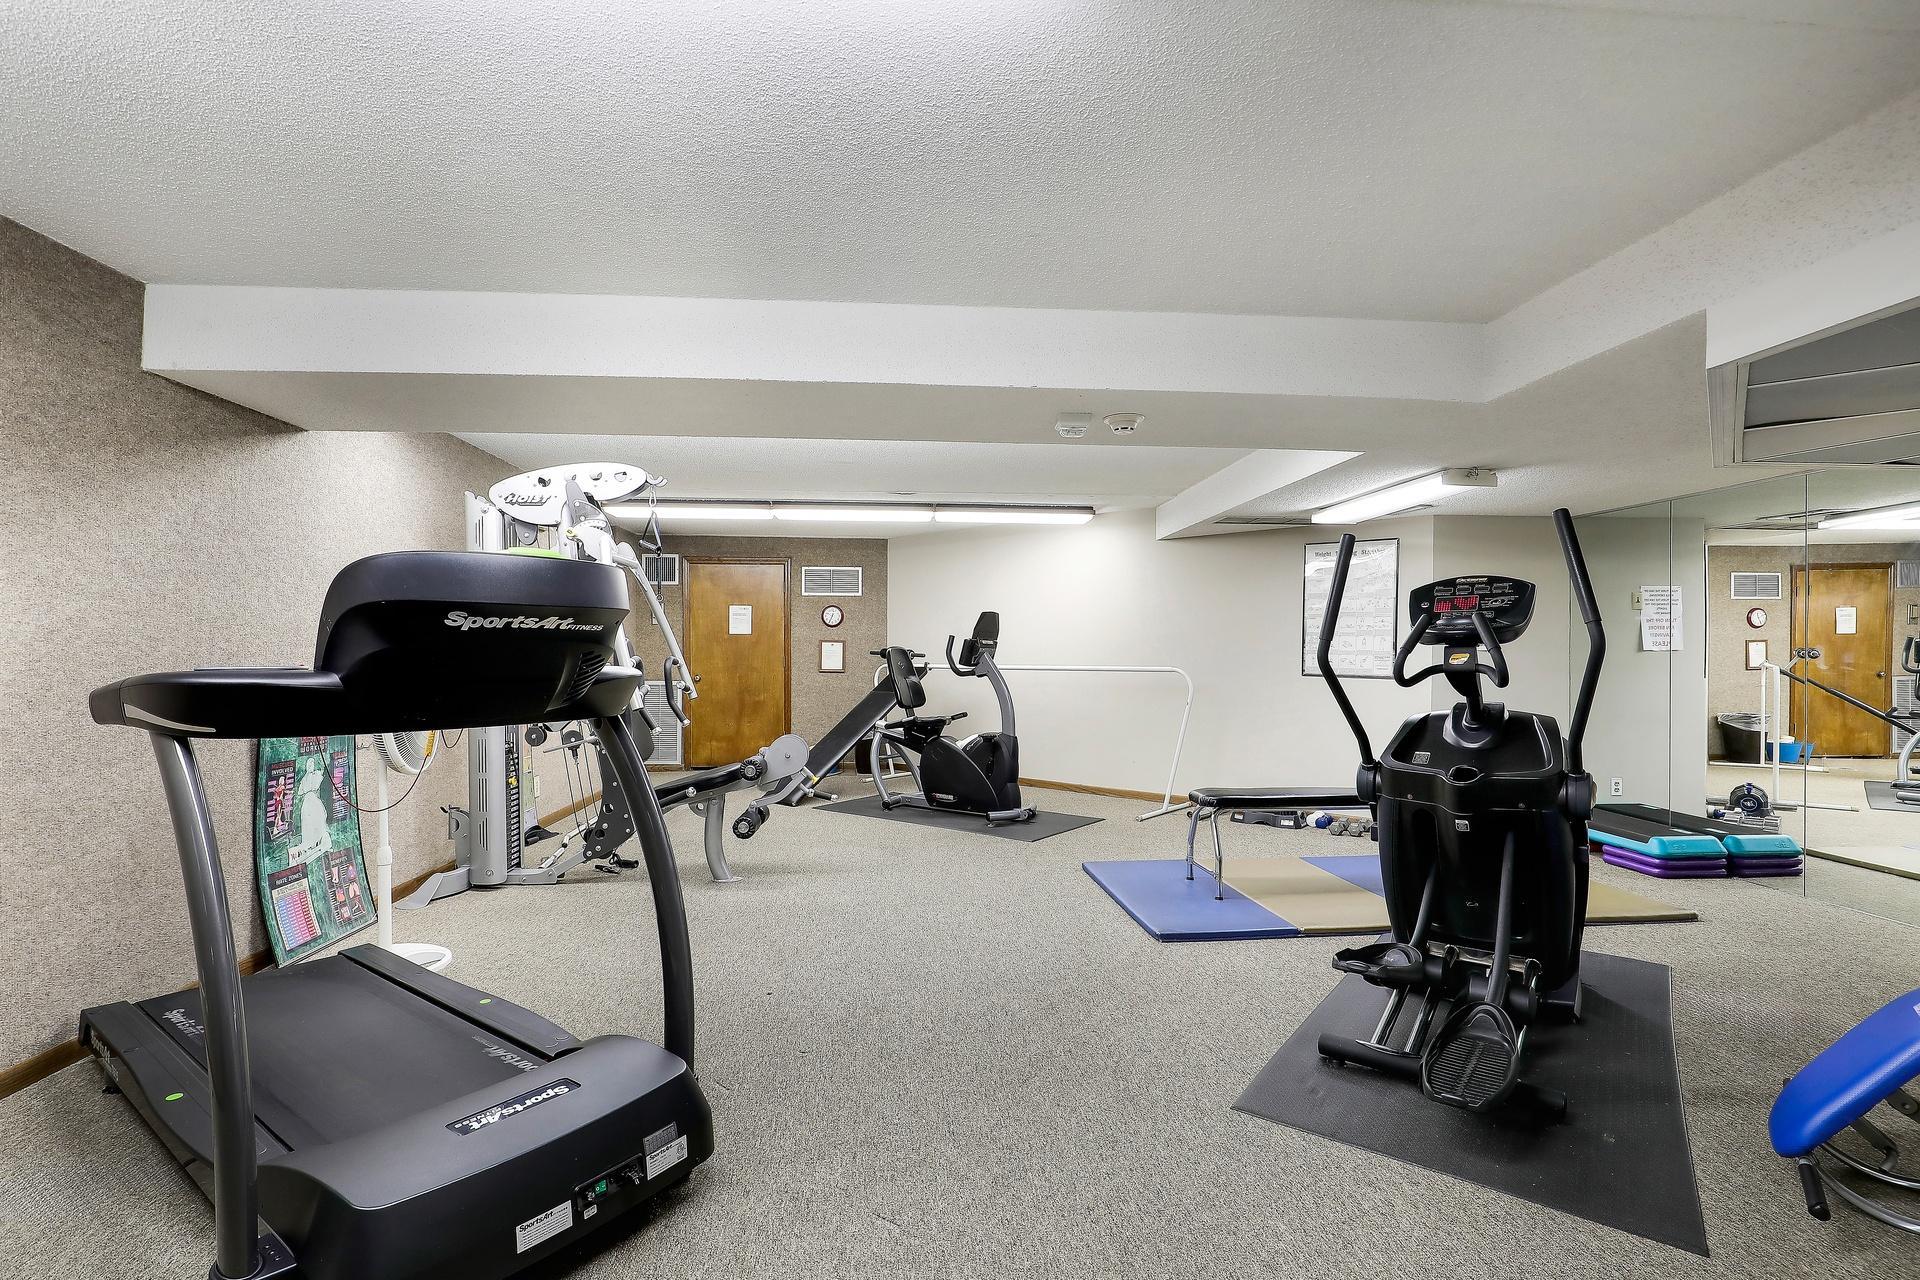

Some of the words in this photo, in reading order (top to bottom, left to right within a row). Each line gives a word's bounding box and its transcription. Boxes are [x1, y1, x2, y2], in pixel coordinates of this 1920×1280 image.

[444, 611, 575, 631] SportsArt
[468, 1085, 570, 1130] SportsArt
[519, 1211, 553, 1233] SportsArt
